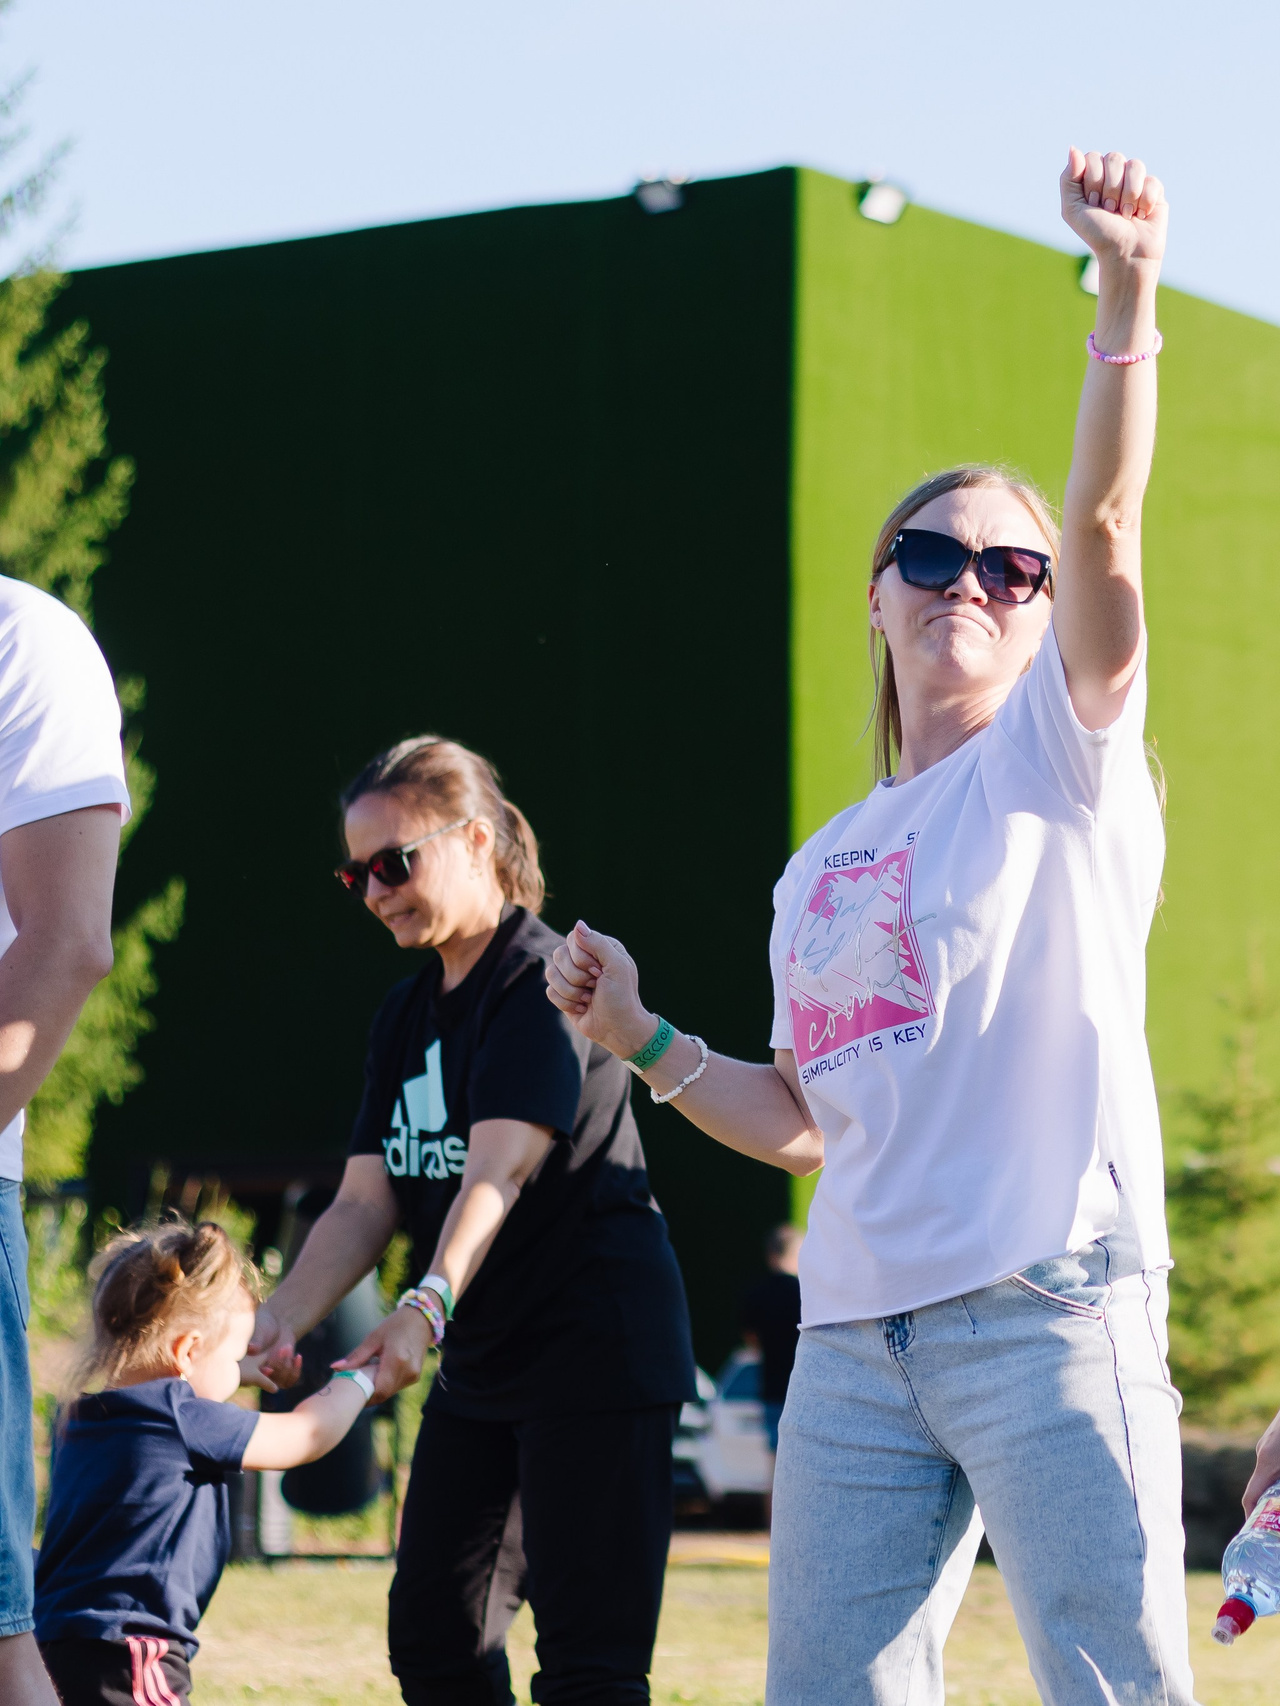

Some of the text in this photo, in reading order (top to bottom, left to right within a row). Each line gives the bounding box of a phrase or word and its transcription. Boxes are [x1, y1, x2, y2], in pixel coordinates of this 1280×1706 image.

[824, 848, 878, 869] KEEPIN'
[802, 1023, 926, 1084] SIMPLICITY IS KEY
